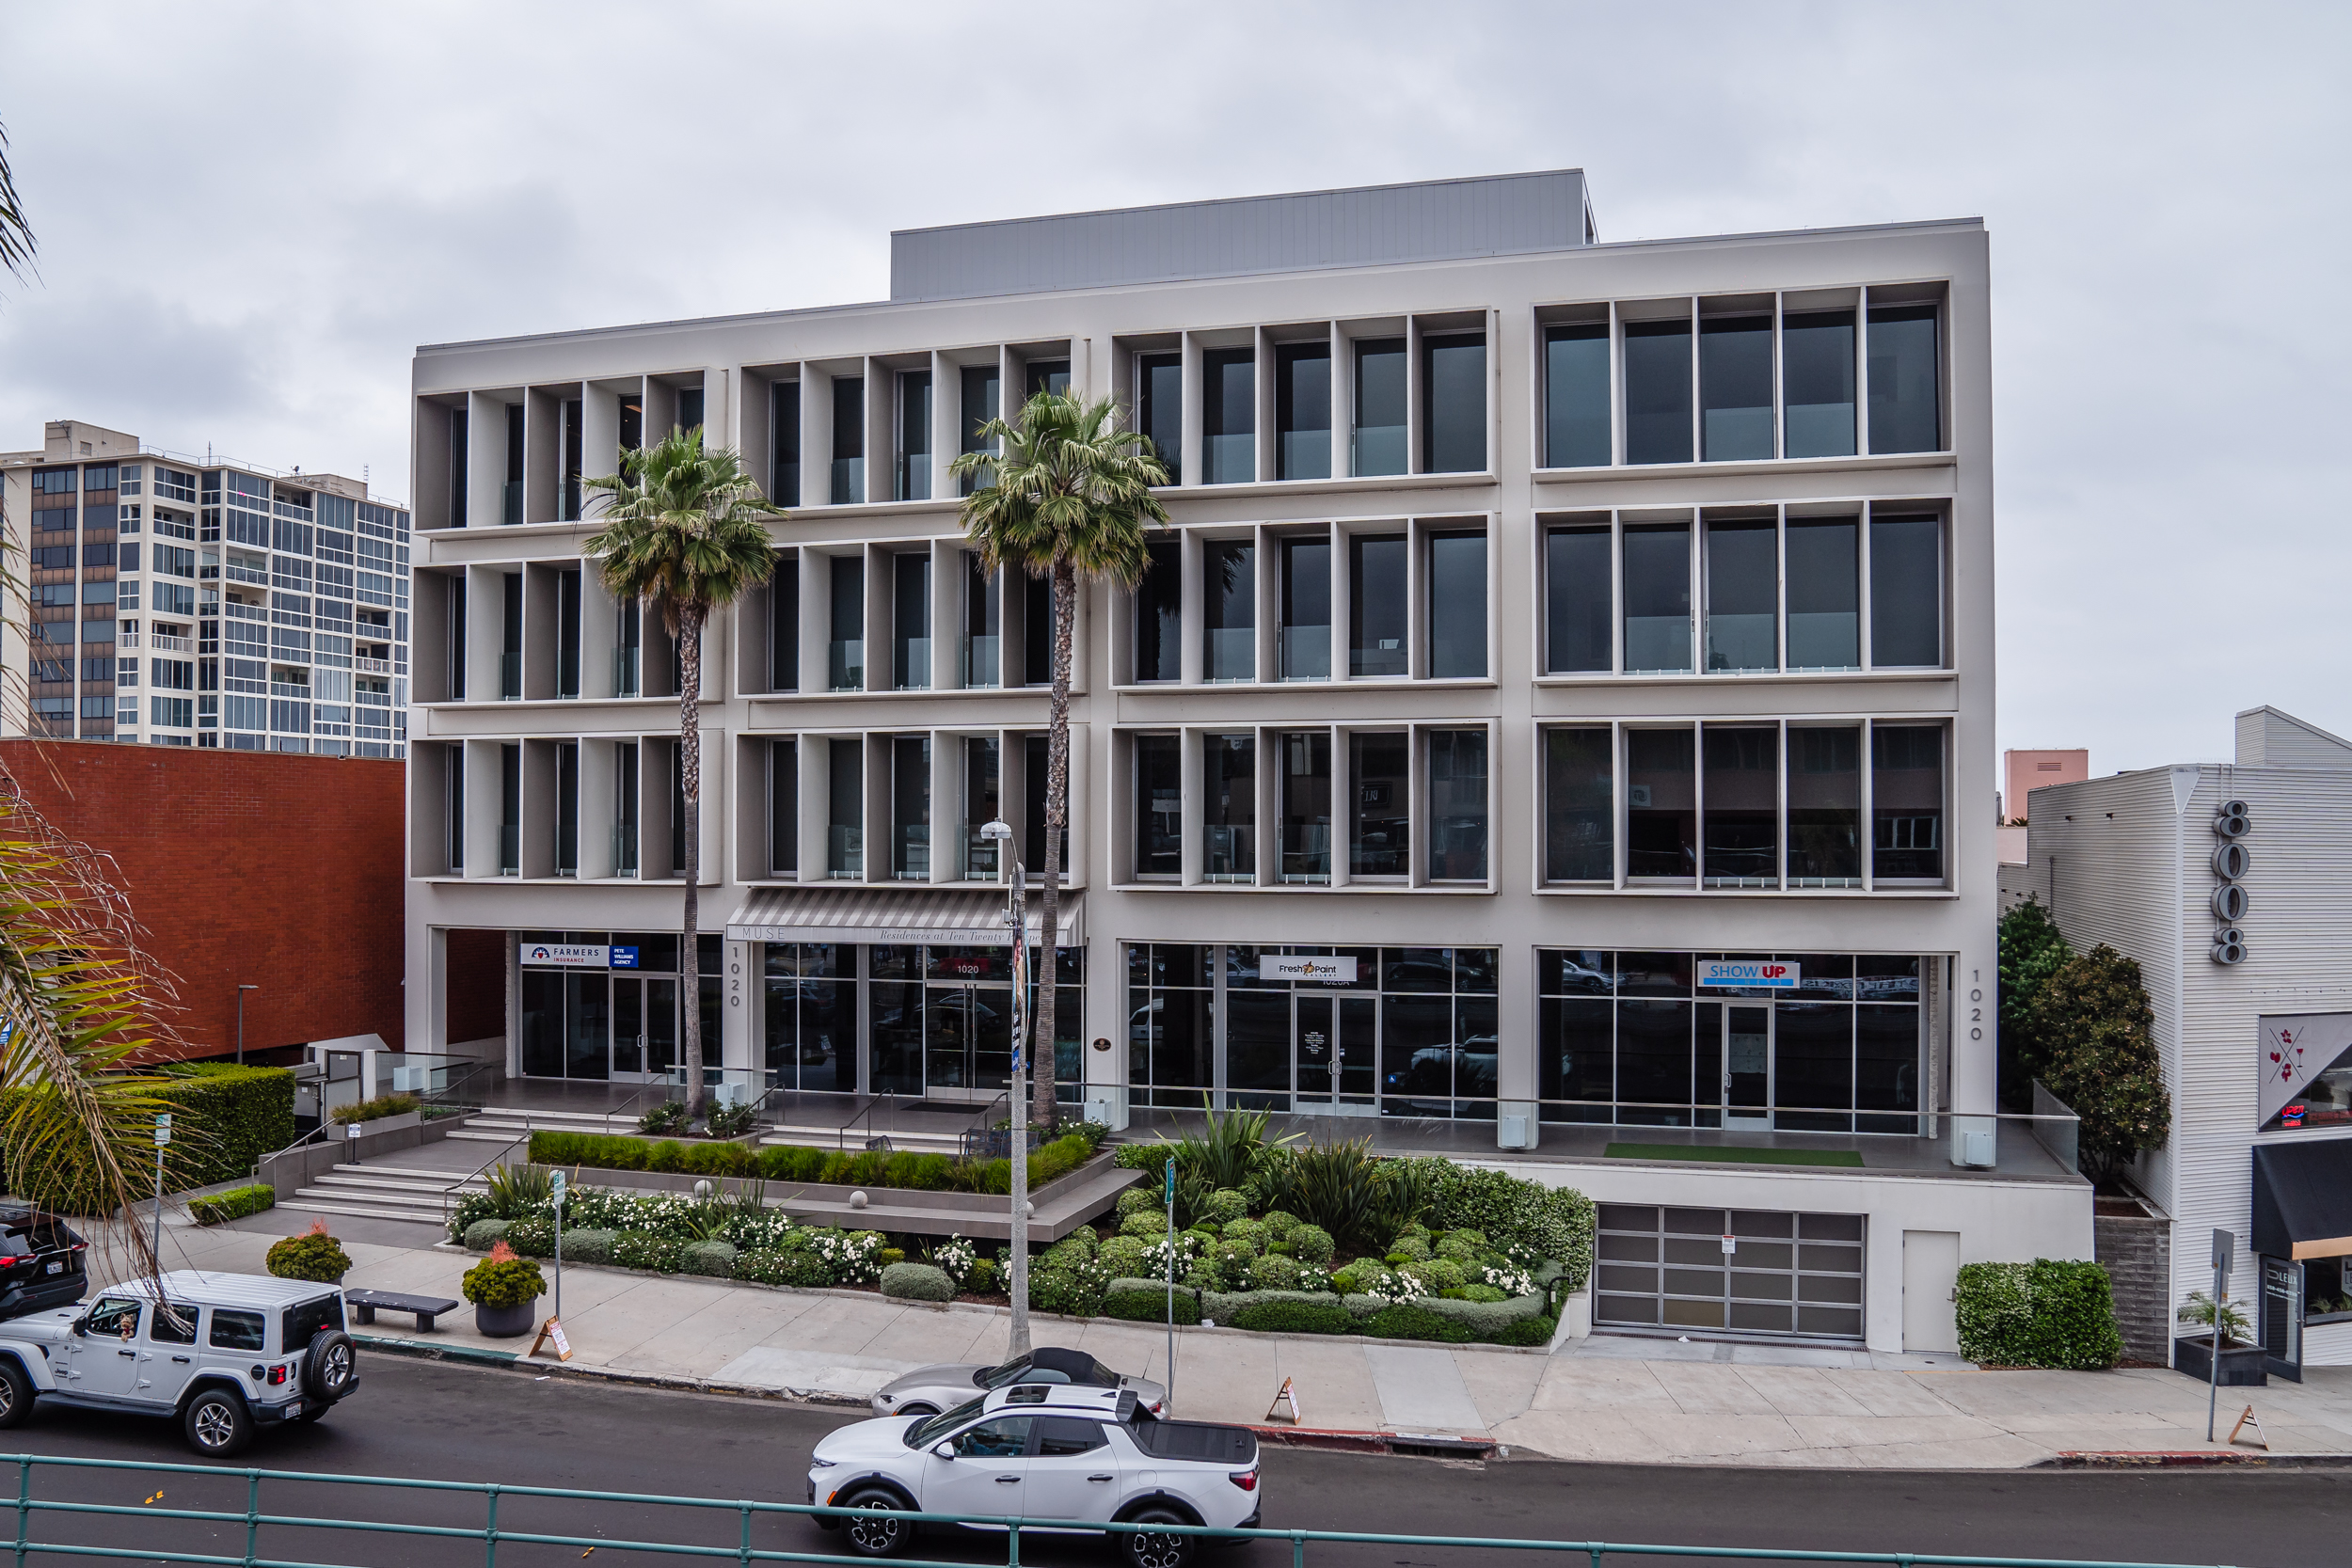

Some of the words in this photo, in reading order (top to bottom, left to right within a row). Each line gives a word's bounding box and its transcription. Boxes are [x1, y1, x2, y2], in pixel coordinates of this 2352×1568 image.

[2210, 800, 2251, 964] 8008
[742, 927, 786, 940] MUSE
[880, 929, 930, 940] Residences
[948, 930, 964, 941] Ten
[970, 931, 1004, 943] Twenty
[553, 947, 599, 957] FARMERS
[730, 946, 740, 1006] 1020
[957, 965, 979, 974] 1020
[1314, 965, 1337, 974] Paint
[1710, 965, 1758, 977] SHOW
[1762, 964, 1787, 978] UP
[1970, 969, 1982, 1040] 1020
